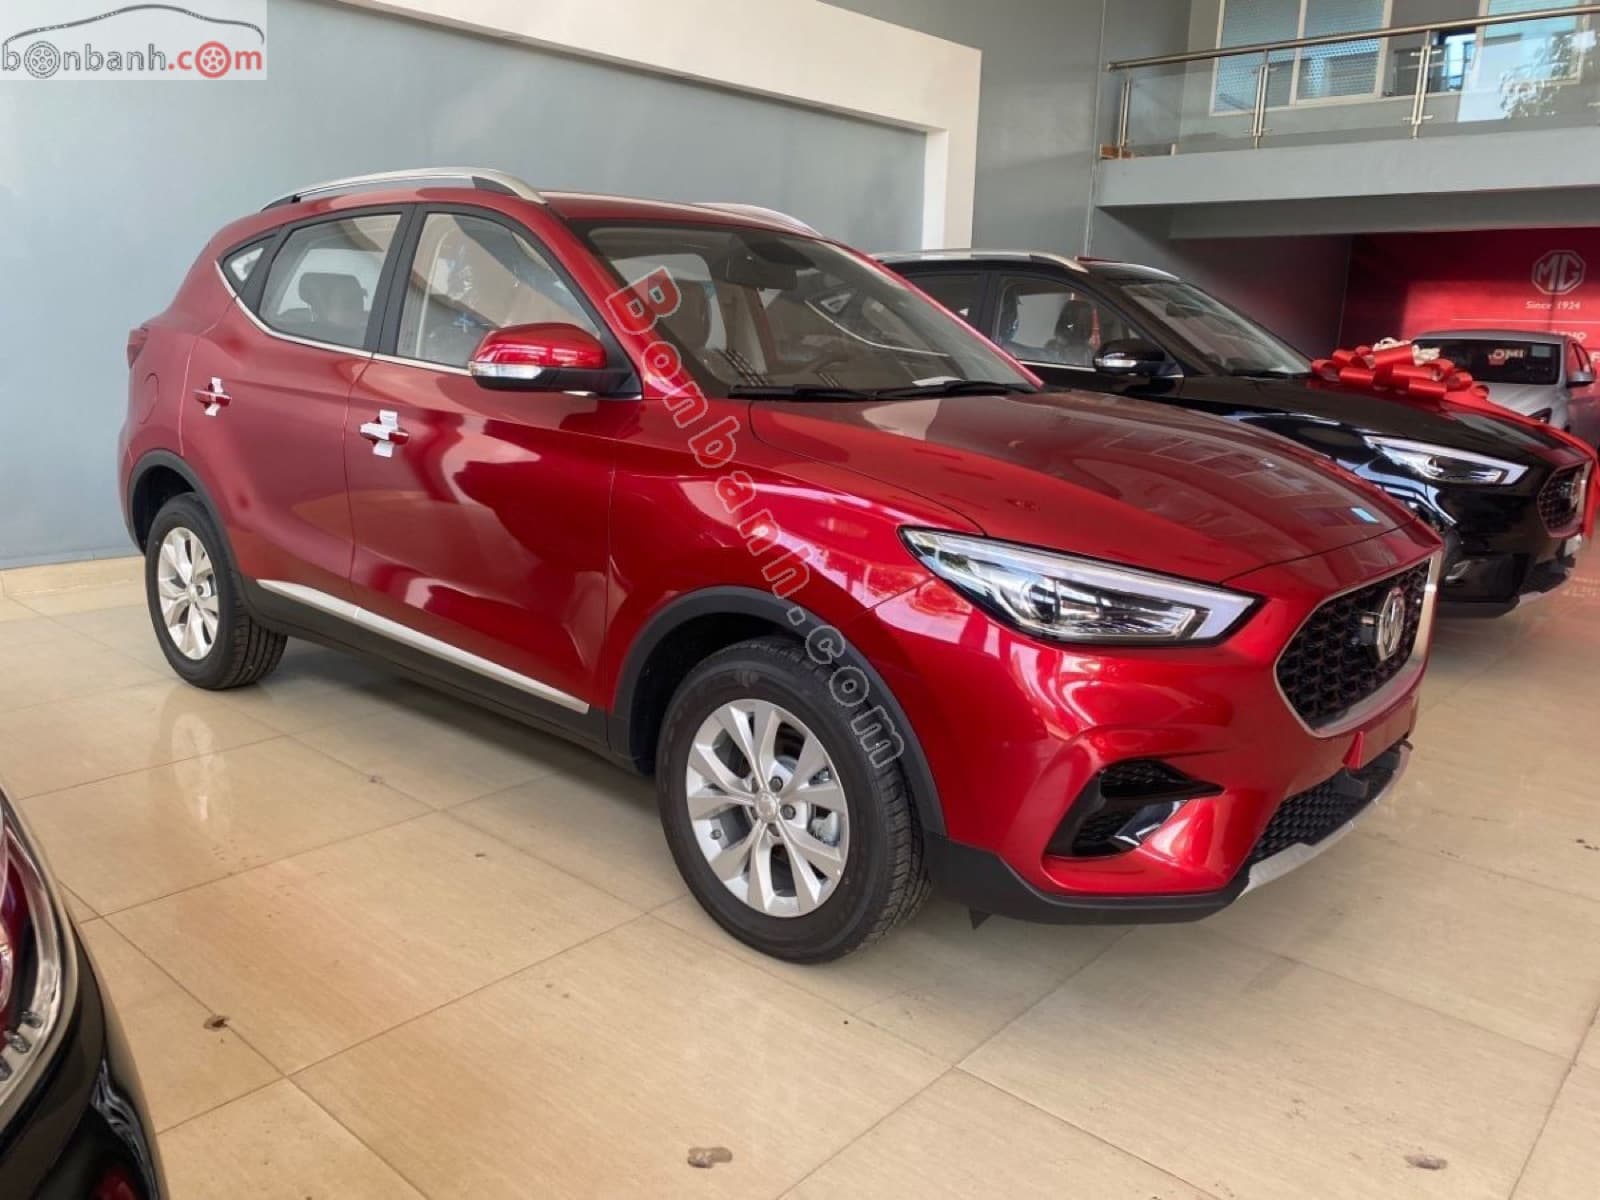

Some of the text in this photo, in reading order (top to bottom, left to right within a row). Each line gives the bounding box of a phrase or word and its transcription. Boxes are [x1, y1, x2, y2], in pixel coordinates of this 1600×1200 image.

[1535, 253, 1581, 292] MG
[1525, 300, 1581, 309] Since 1924
